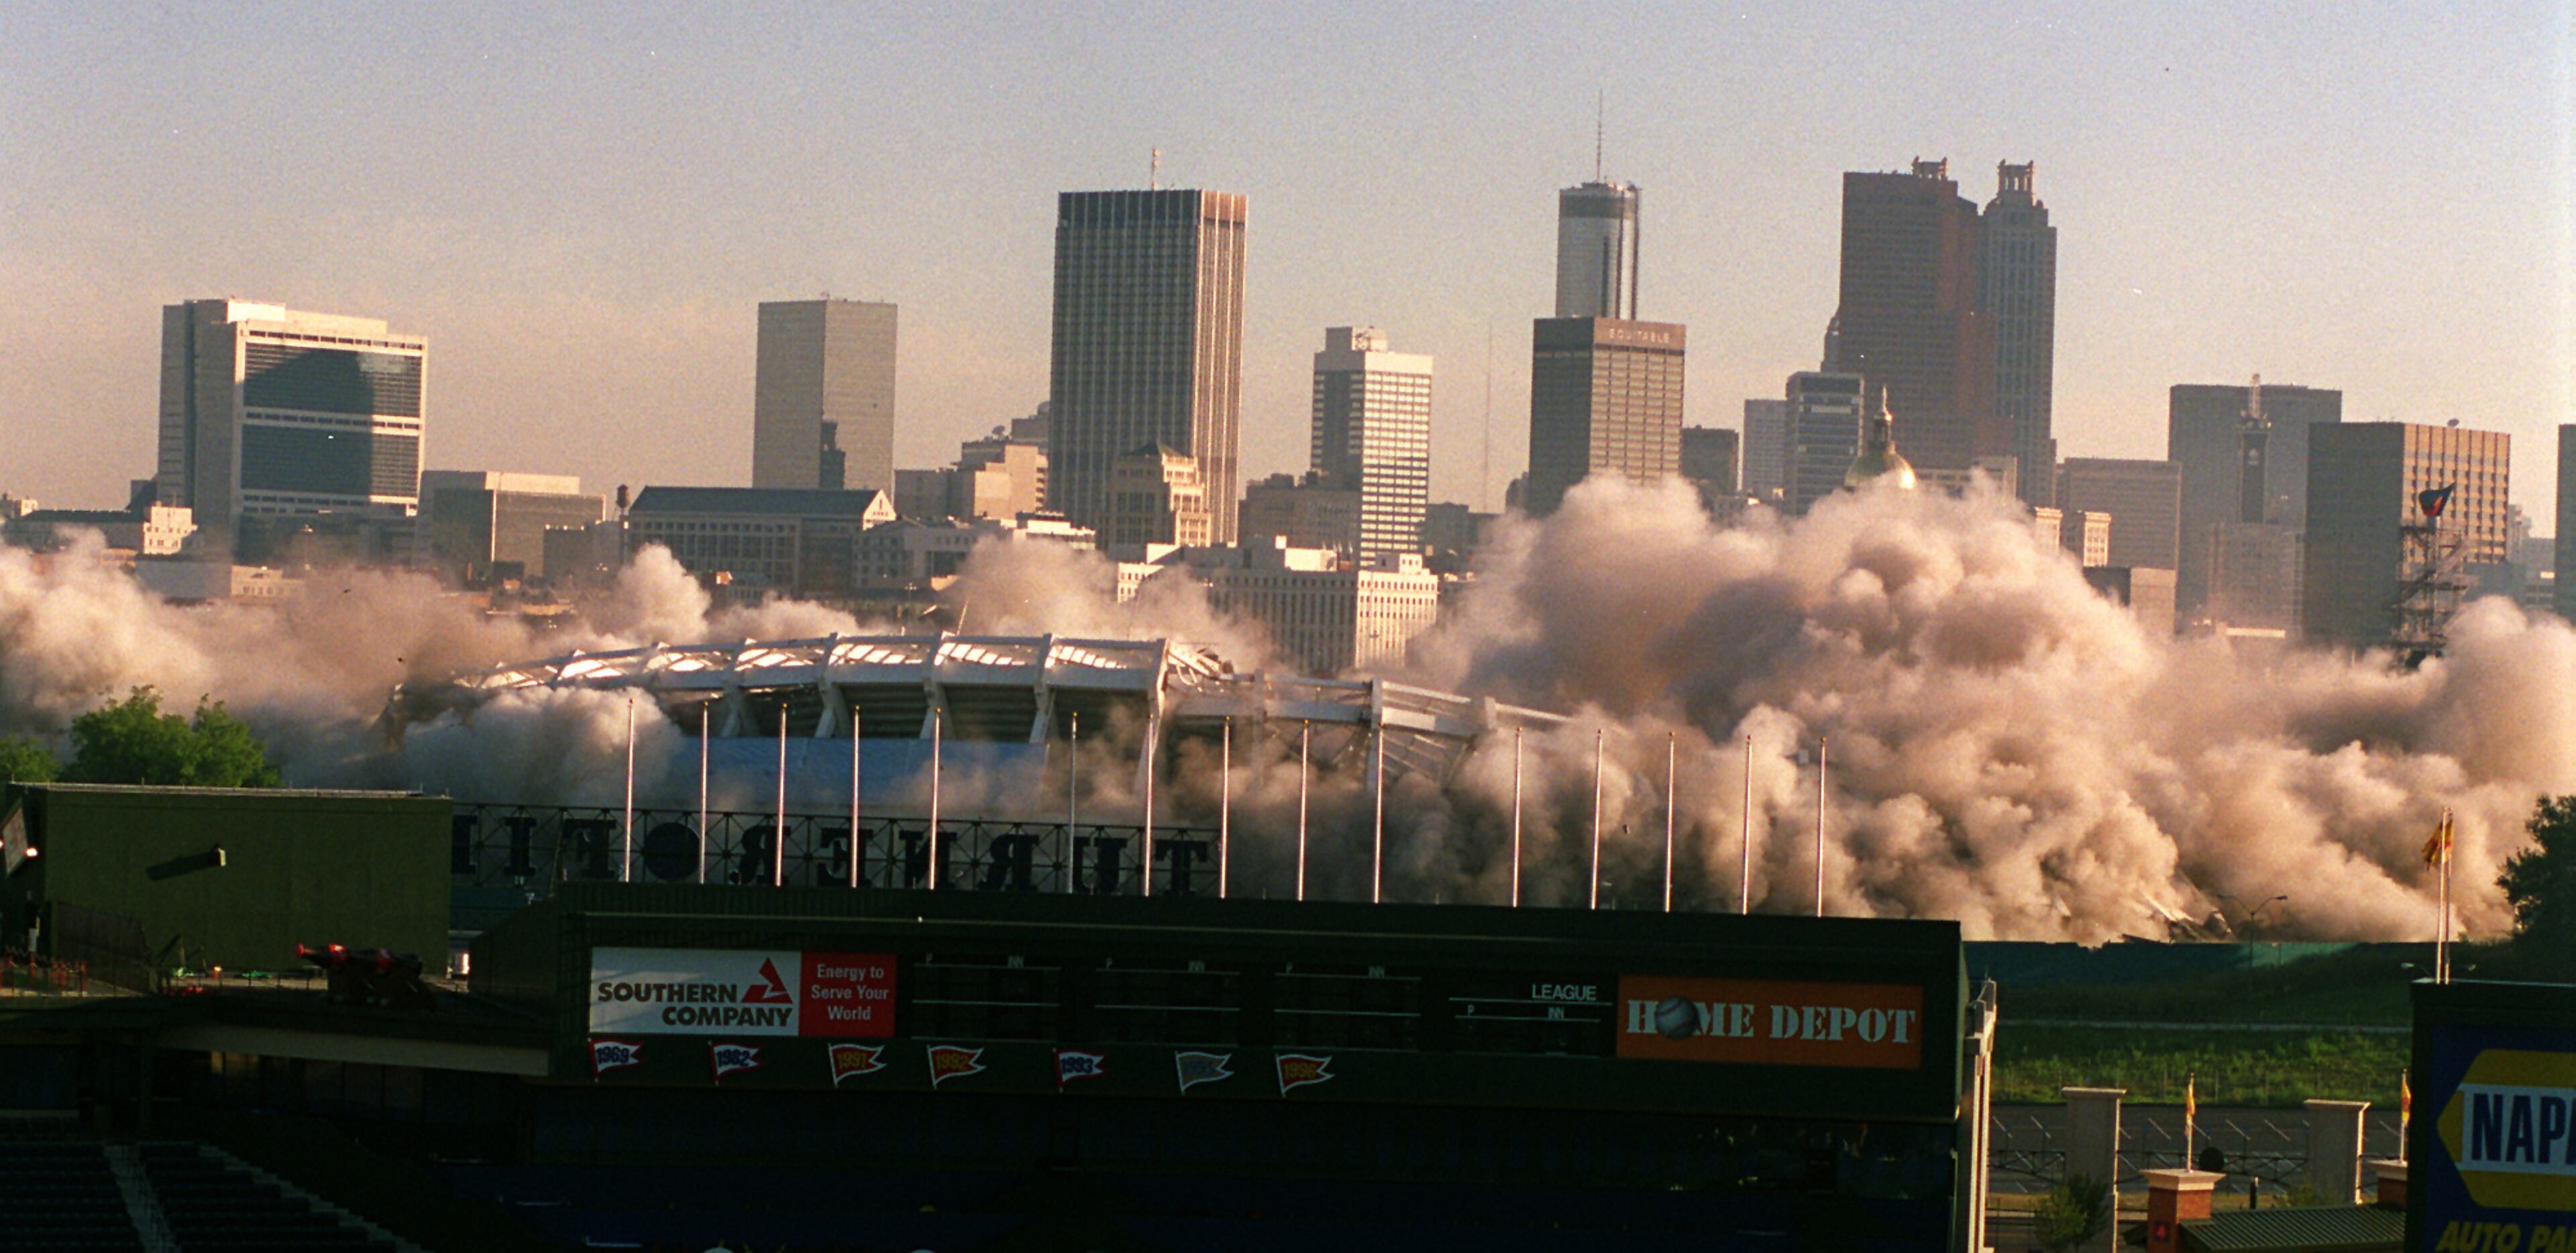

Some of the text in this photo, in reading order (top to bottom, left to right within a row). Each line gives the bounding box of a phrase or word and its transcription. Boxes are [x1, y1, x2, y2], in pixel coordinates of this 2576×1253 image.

[1609, 328, 1670, 343] EQUTABLE
[816, 963, 884, 981] Energy to
[598, 982, 737, 1003] SOUTHERN
[811, 985, 890, 1001] Serve Your
[1532, 983, 1597, 1001] LEAGUE
[662, 1007, 793, 1027] COMPANY
[827, 1005, 871, 1021] World
[1770, 1005, 1916, 1043] DEPOT
[596, 1047, 629, 1065] 1969
[717, 1049, 750, 1067] 1982
[837, 1051, 867, 1070] 1991
[935, 1053, 969, 1072] 1992
[1061, 1057, 1093, 1074] 1993
[2435, 1220, 2522, 1253] AUTO
